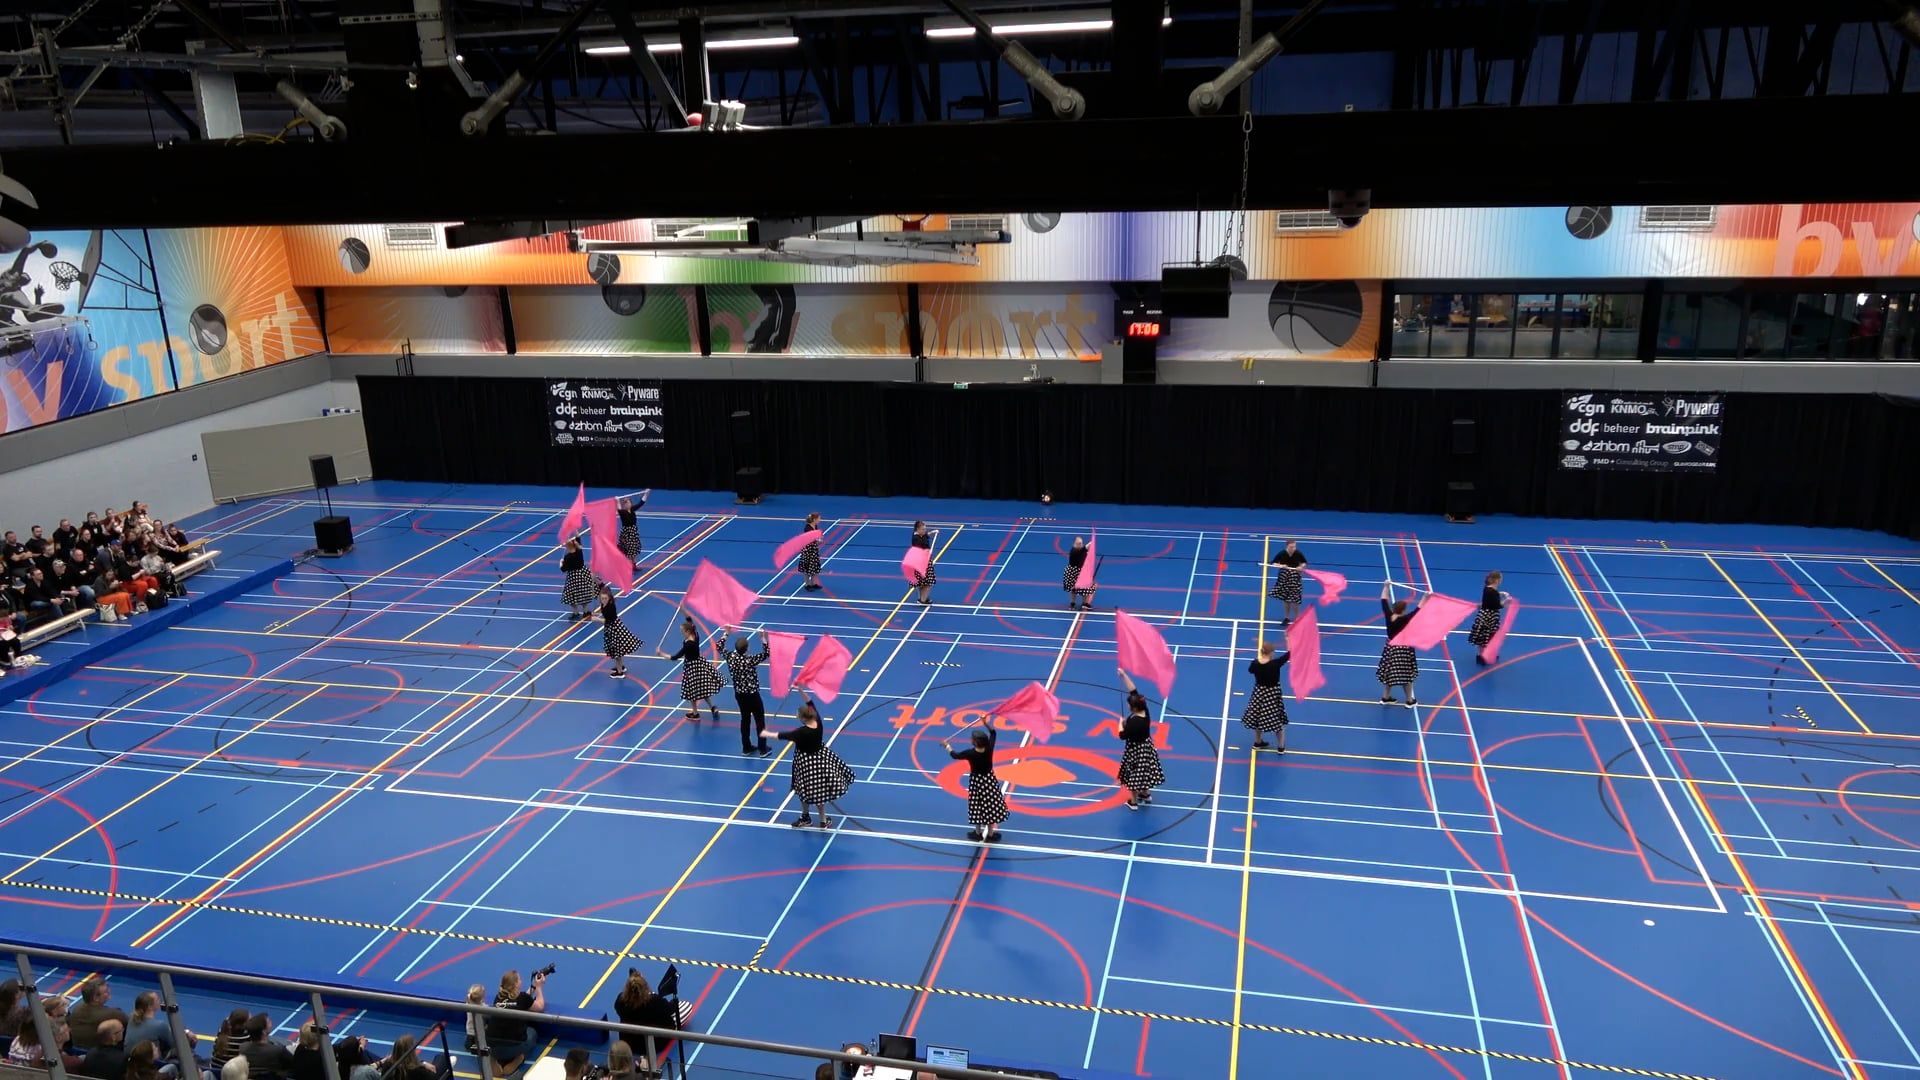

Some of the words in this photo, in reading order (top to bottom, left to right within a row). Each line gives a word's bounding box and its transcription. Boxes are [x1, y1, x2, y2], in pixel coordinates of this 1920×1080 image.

[0, 360, 64, 433] v
[559, 390, 578, 401] cgn
[627, 385, 660, 401] Pyware
[555, 402, 578, 418] ddf
[580, 406, 607, 415] beheer
[610, 405, 662, 417] brainpink
[1578, 403, 1605, 416] cgn
[1611, 404, 1647, 414] KNMO
[1675, 399, 1720, 417] Pyware
[1569, 418, 1600, 436] ddf
[1604, 423, 1640, 434] beheer
[1646, 422, 1719, 436] brainpink
